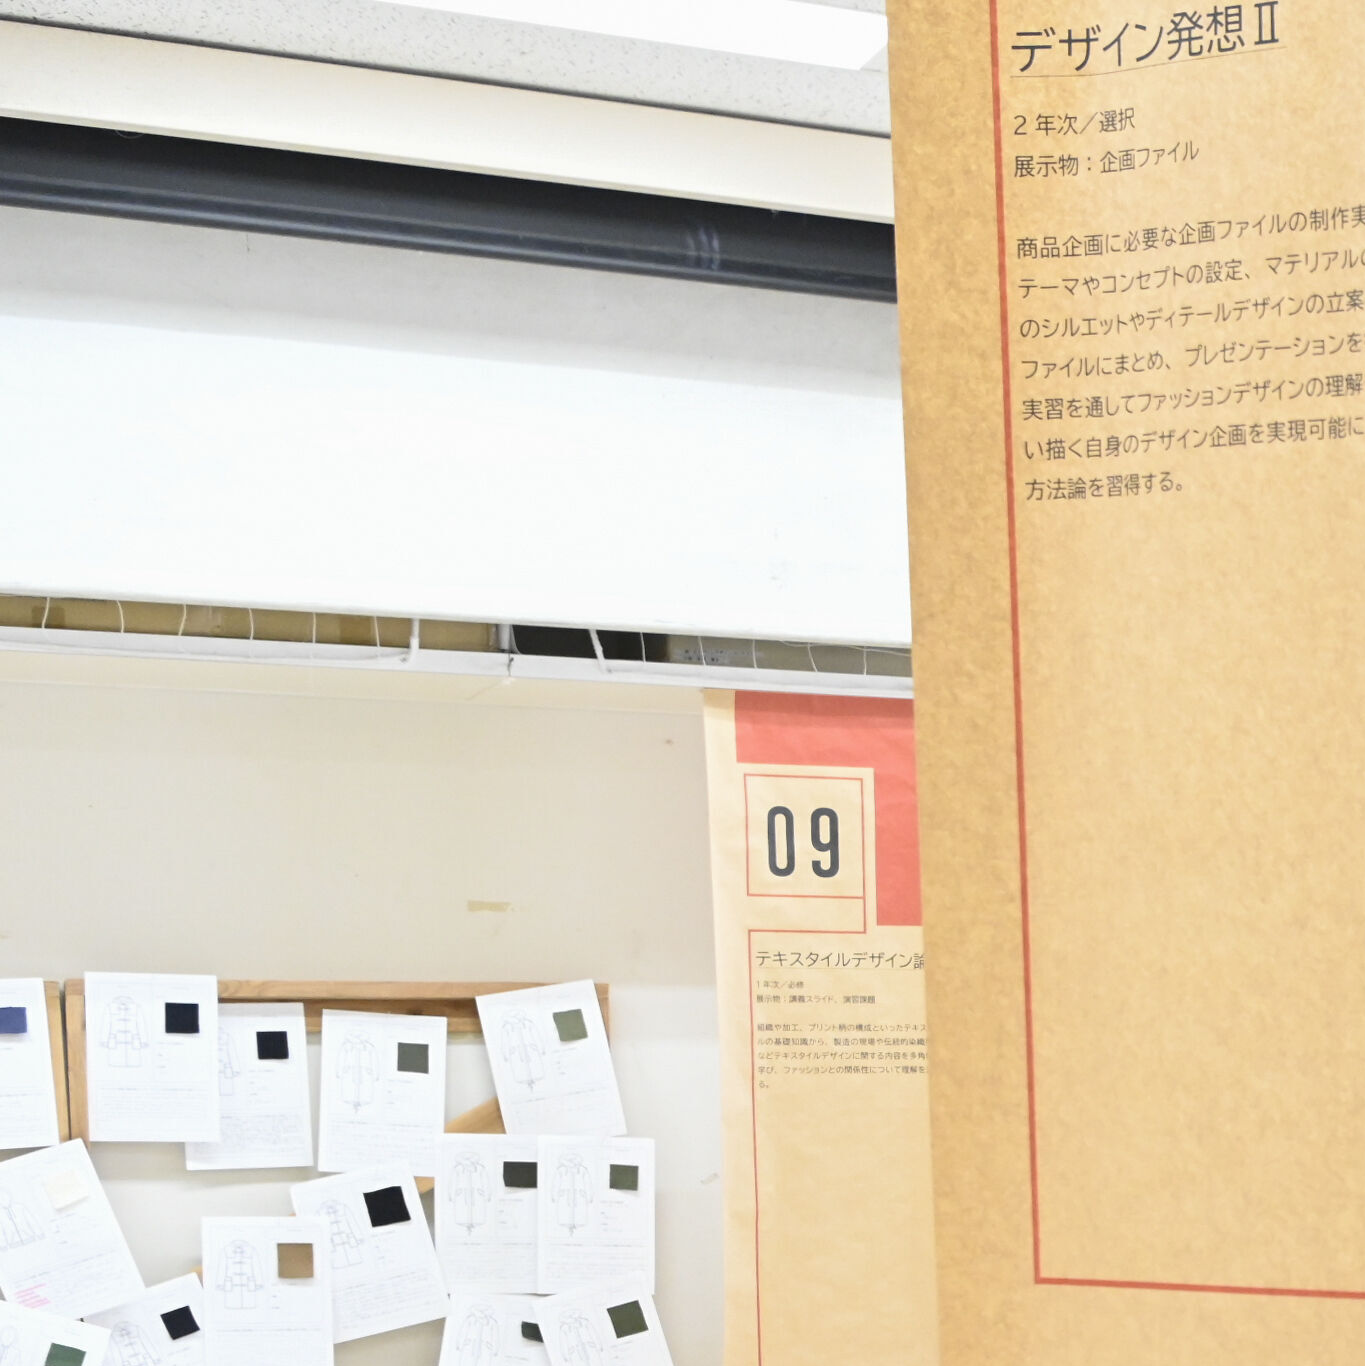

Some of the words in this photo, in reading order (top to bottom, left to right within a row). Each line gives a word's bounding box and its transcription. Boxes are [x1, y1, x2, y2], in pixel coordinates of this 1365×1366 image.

[1024, 471, 1184, 501] 方法論を習得する。
[766, 805, 840, 878] 09
